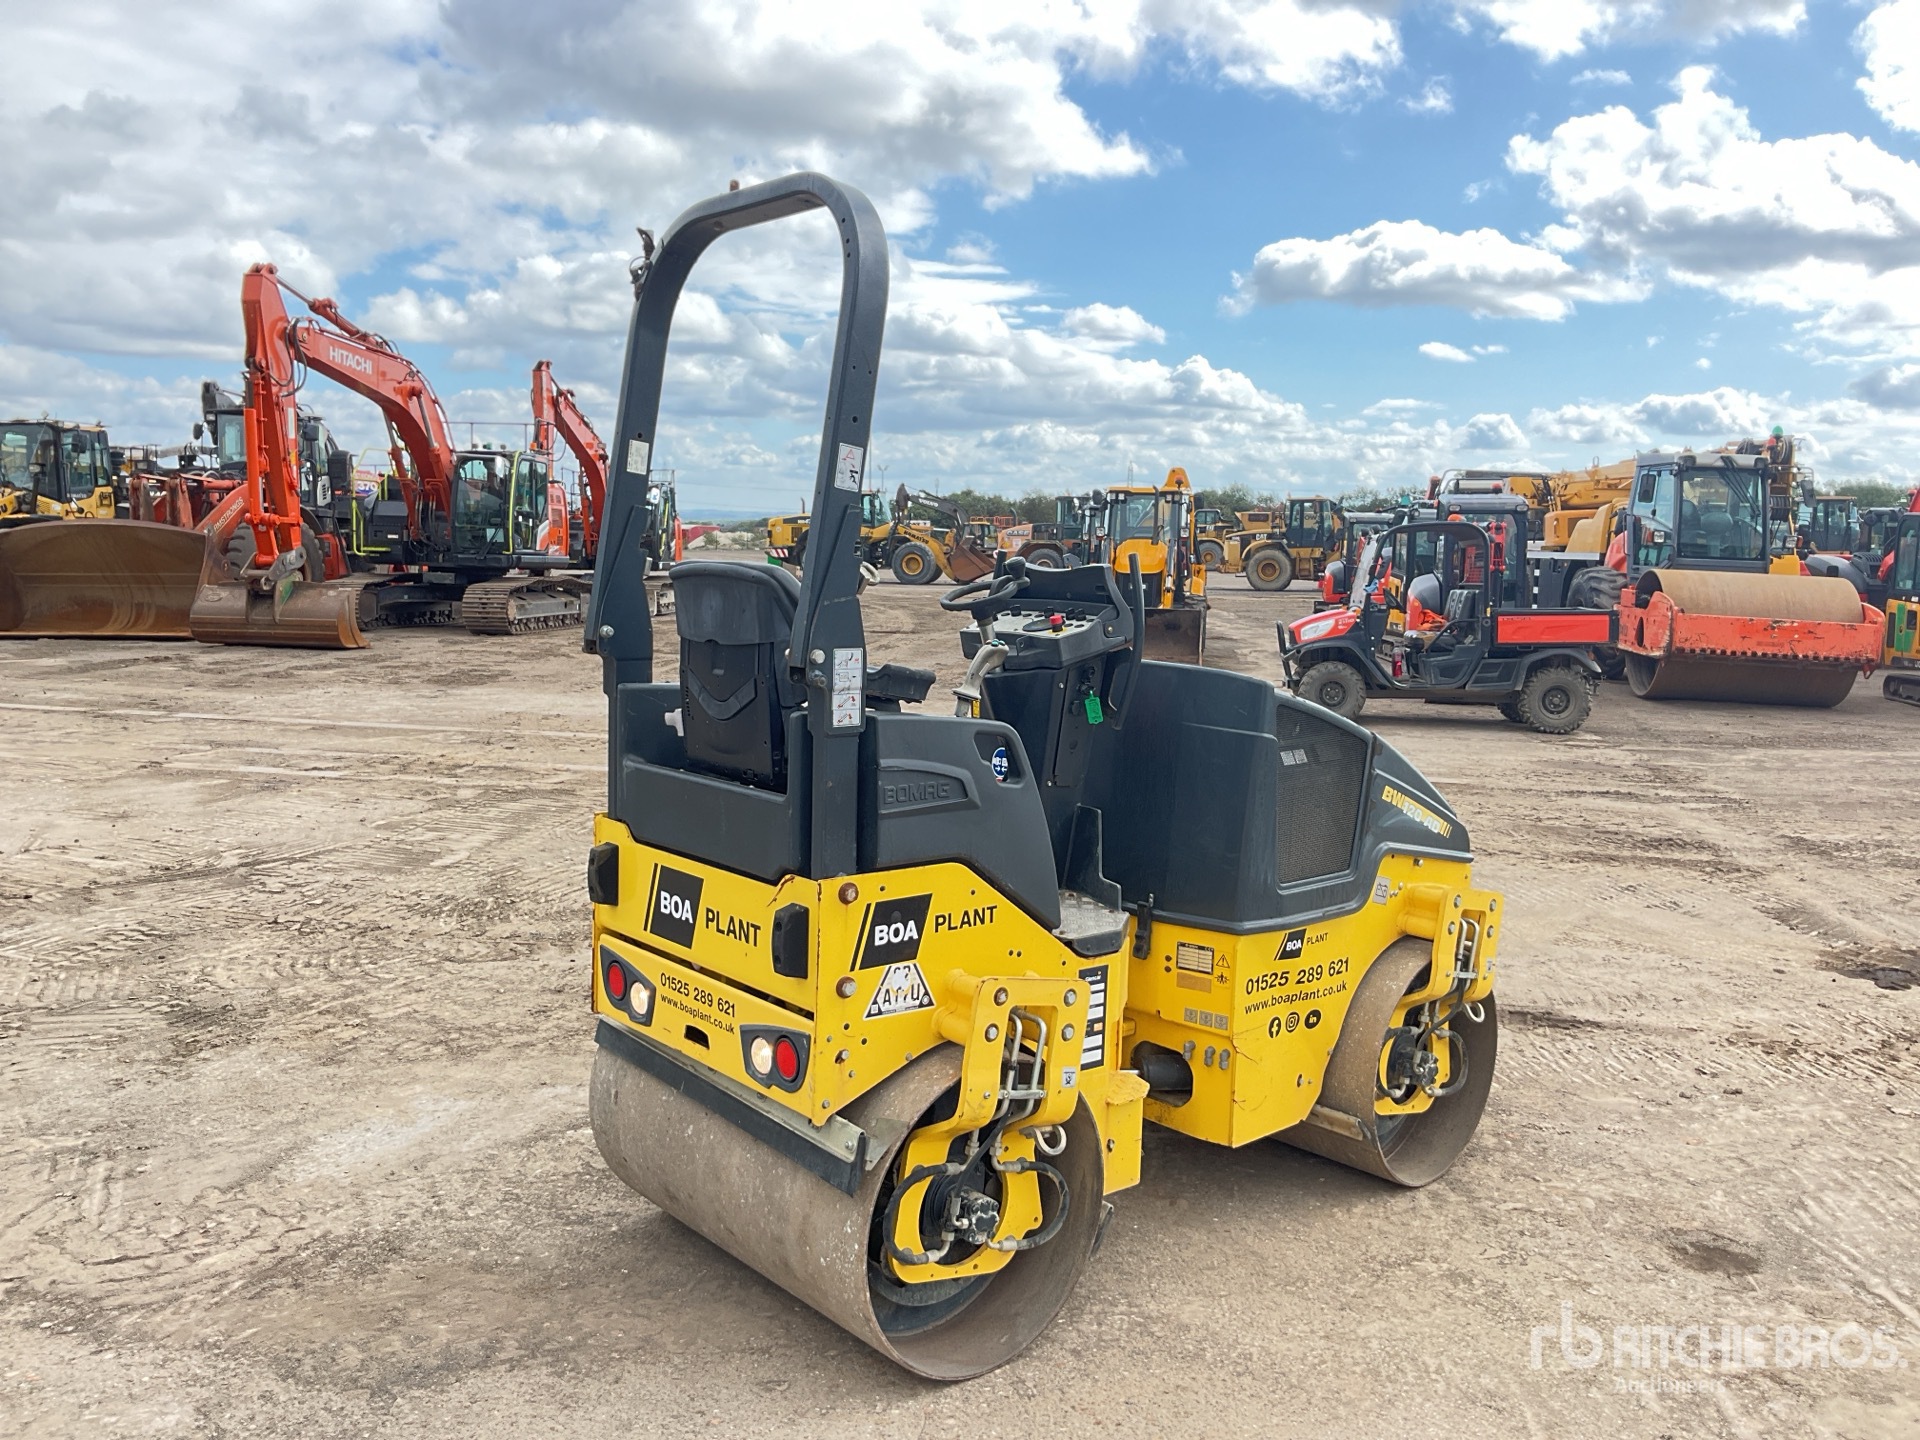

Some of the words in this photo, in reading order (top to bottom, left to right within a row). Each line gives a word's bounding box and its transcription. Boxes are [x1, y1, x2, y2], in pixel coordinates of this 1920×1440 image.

[329, 345, 373, 375] HITACHI
[213, 496, 244, 531] RMSTRONGS
[918, 498, 938, 507] VOLVO
[903, 530, 929, 545] KOMATSU
[1255, 533, 1267, 541] CAT
[883, 781, 950, 805] BOMAG
[660, 890, 694, 923] BOA
[705, 907, 762, 947] PLANT
[874, 920, 919, 946] BOA
[934, 905, 998, 933] PLANT
[1285, 939, 1302, 951] BOA
[1306, 932, 1329, 946] PLANT
[1246, 970, 1290, 995] 01525
[1295, 964, 1324, 985] 289
[1328, 957, 1350, 977] 621
[660, 972, 690, 997] 01525
[693, 987, 714, 1008] 289
[717, 997, 736, 1018] 621
[1244, 980, 1348, 1015] www.boaplant.co.uk
[660, 993, 735, 1035] www.boaplant.co.uk
